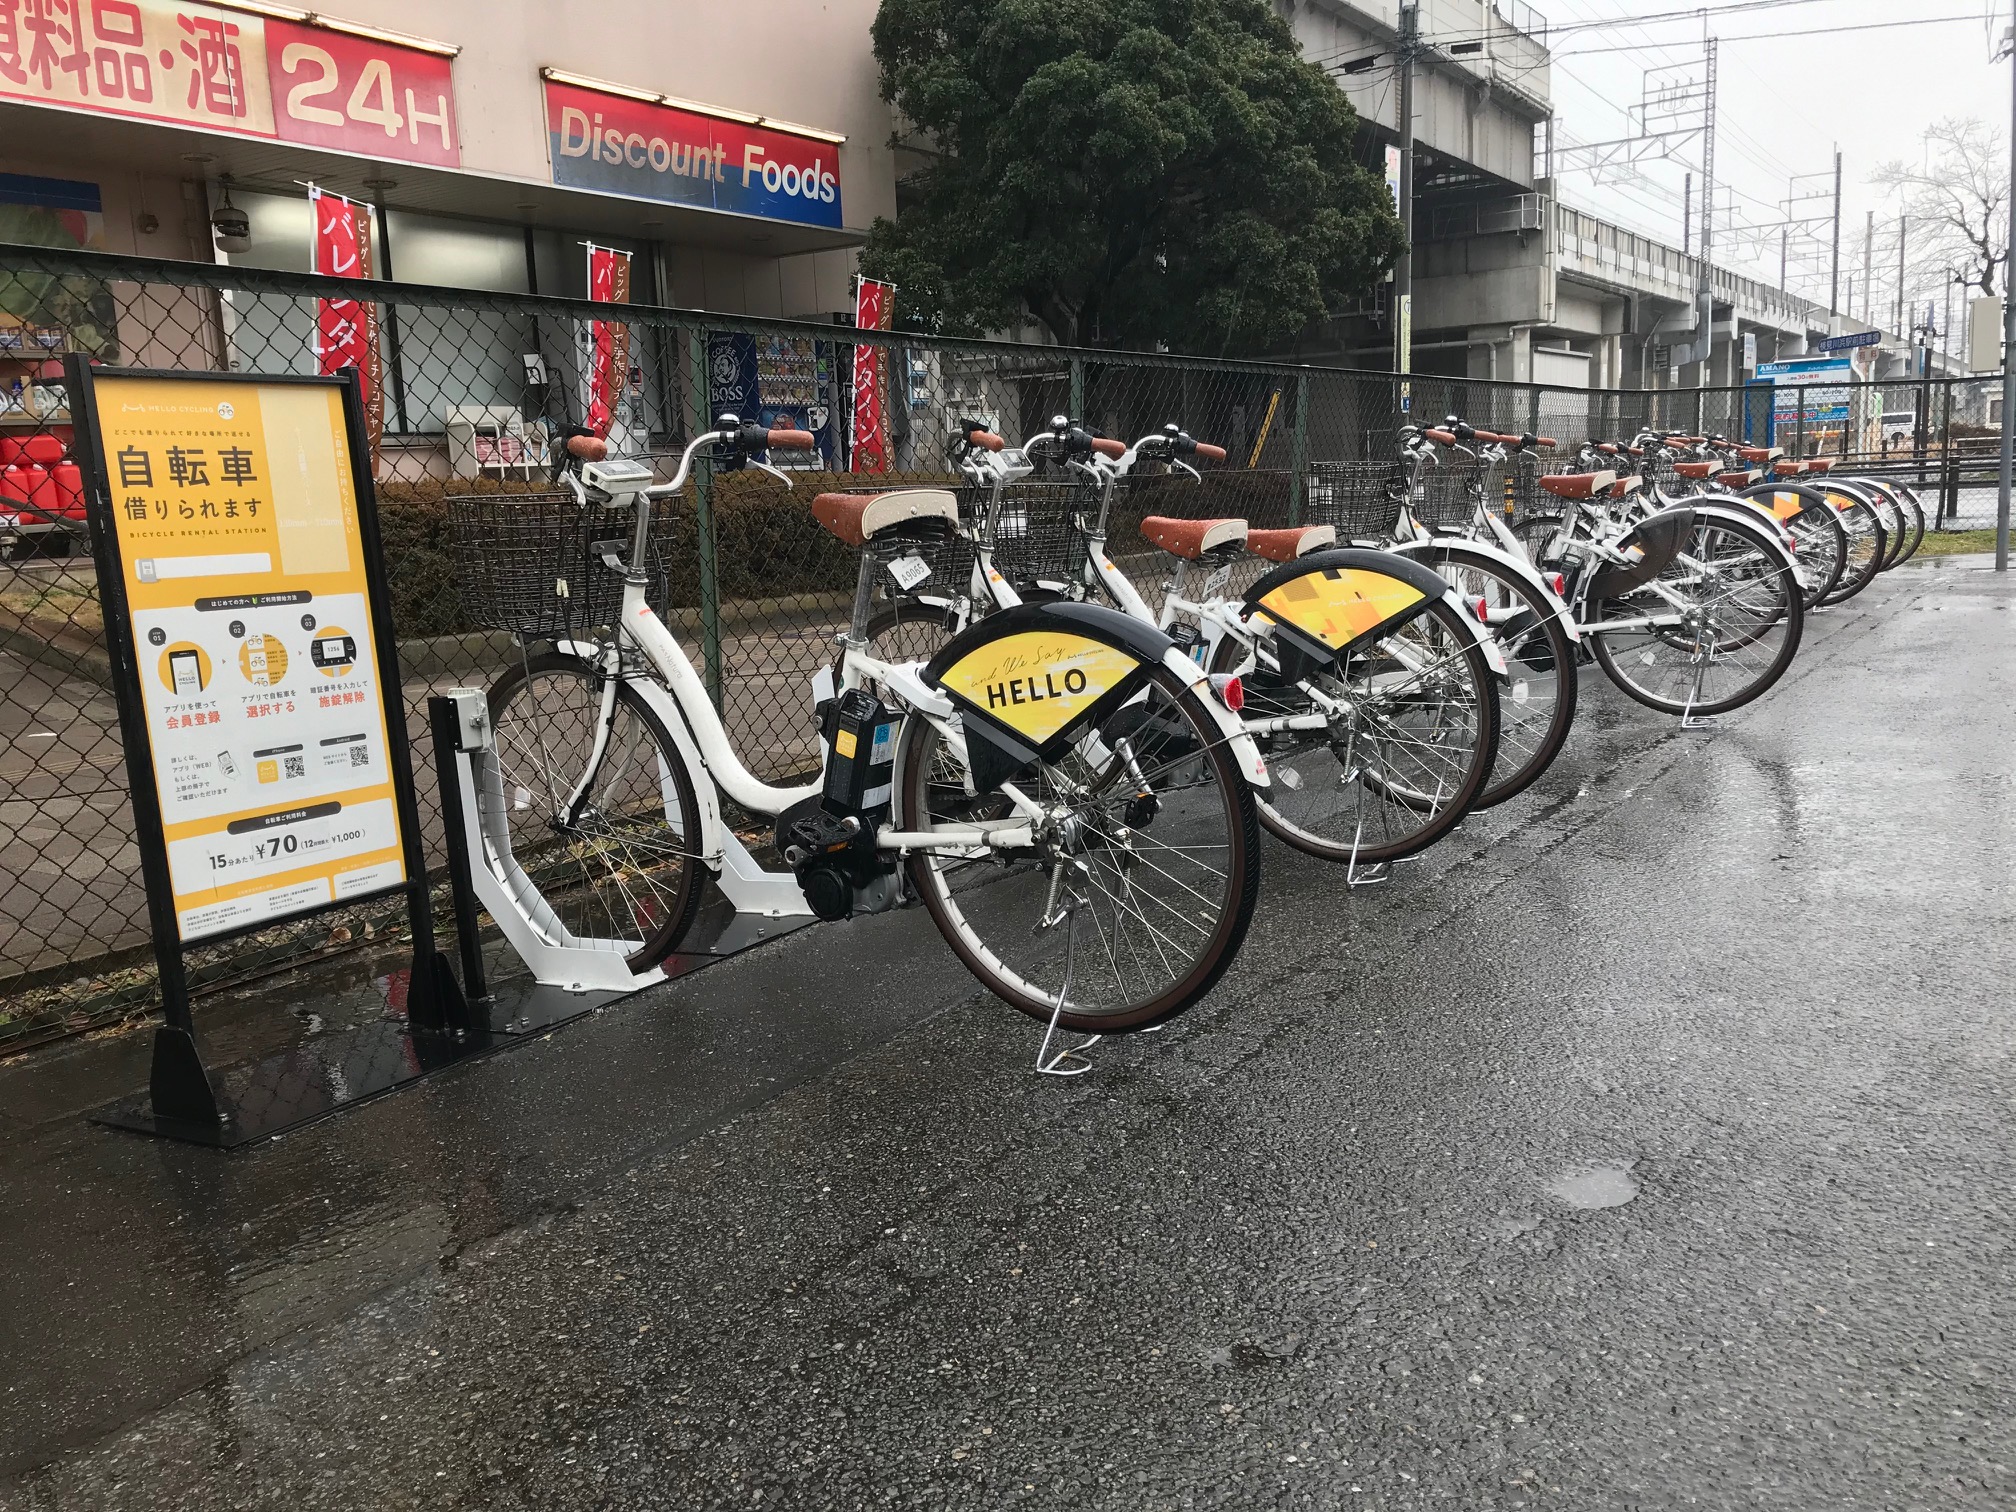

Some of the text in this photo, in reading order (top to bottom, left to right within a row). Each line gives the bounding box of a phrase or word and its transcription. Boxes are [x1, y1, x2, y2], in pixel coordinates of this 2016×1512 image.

[280, 43, 451, 151] 24H
[559, 106, 836, 204] Discount Foods
[1759, 364, 1791, 372] AMANO
[710, 385, 743, 402] BOSS
[148, 404, 214, 413] HELLO CYCLING
[116, 444, 258, 489] 自転車
[123, 496, 262, 520] 借りられます
[129, 527, 268, 539] BICYCLE RENTAL STATION
[901, 563, 925, 584] A9065
[970, 646, 1066, 688] and We Say
[241, 689, 297, 703] アプリで自転車を
[986, 668, 1087, 709] HELLO
[164, 700, 217, 713] アプリを使って
[245, 701, 296, 719] 選択する
[166, 710, 221, 730] 会員登録
